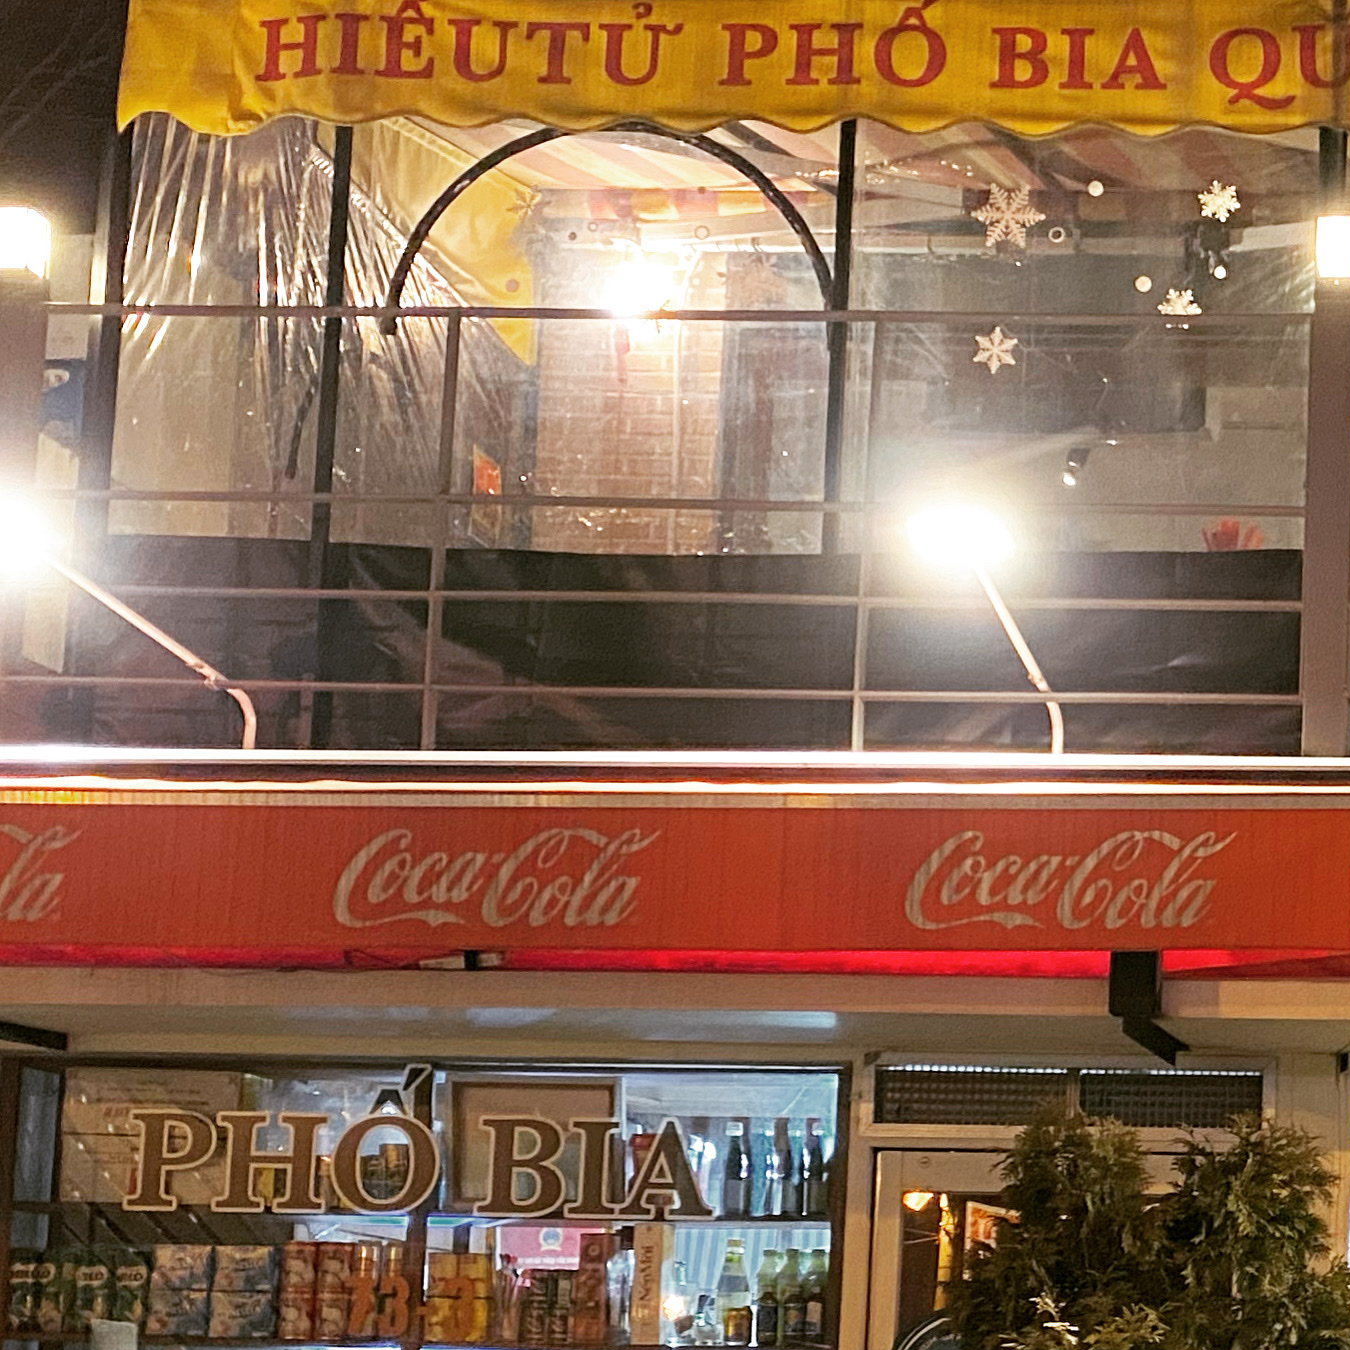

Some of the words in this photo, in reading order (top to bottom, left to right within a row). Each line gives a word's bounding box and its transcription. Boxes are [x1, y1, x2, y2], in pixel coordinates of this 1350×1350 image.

[989, 26, 1168, 92] BIA
[332, 828, 661, 929] Coca-Cola
[904, 830, 1238, 931] Coca-Cola
[122, 1063, 440, 1214] PHỐ
[473, 1115, 718, 1221] BIA
